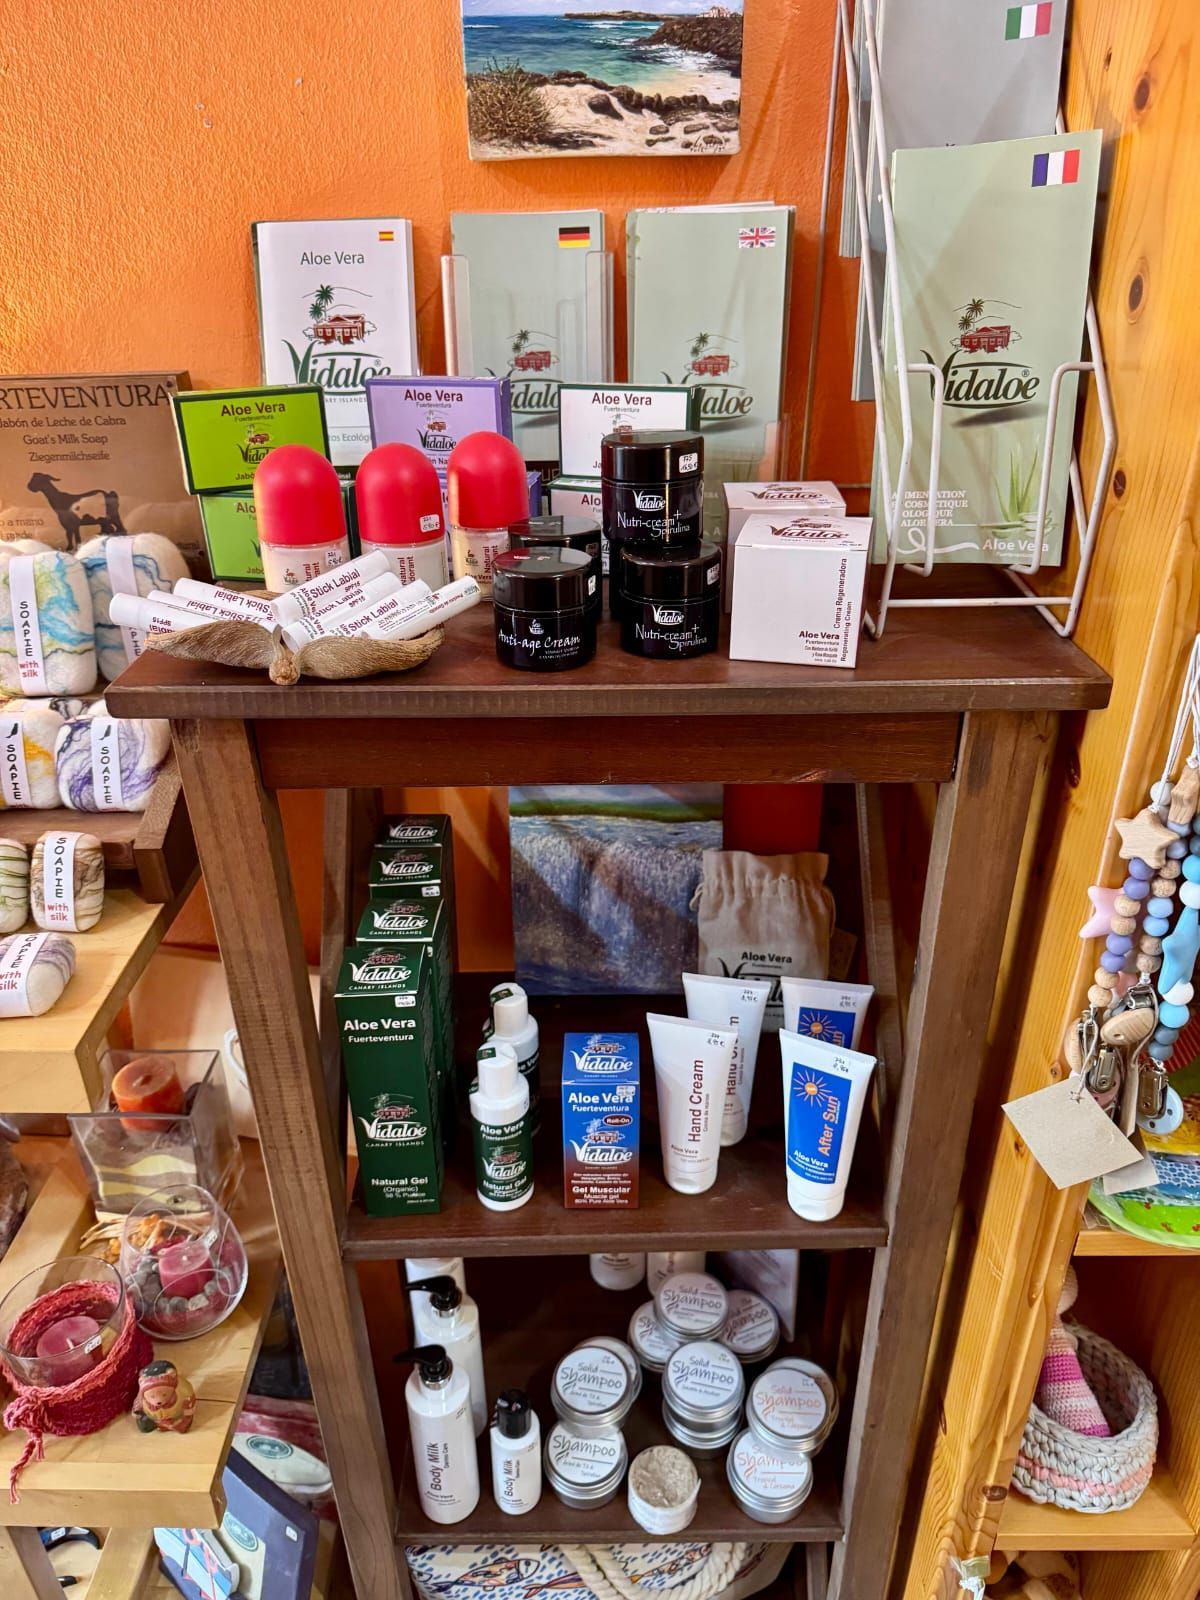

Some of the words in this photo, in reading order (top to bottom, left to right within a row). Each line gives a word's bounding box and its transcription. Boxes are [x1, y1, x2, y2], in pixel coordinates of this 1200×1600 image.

[300, 251, 331, 265] Aloe
[334, 251, 365, 265] Vera
[919, 349, 1041, 403] Vidaloe
[404, 389, 432, 401] Aloe
[435, 390, 464, 402] Vera
[592, 392, 620, 405] Aloe
[624, 393, 652, 406] Vera
[221, 403, 252, 417] Aloe
[255, 402, 286, 414] Vera
[604, 405, 640, 413] Fuerteventura
[32, 416, 43, 426] de
[47, 416, 77, 427] Leche
[79, 415, 92, 426] de
[94, 415, 127, 426] Cabra
[23, 434, 56, 445] Goat's
[58, 433, 80, 444] Milk
[82, 433, 108, 446] Soap
[416, 428, 457, 451] Vidaloe
[236, 443, 268, 465] Vidal
[236, 502, 255, 514] Alo
[581, 494, 602, 507] Alo
[632, 489, 666, 512] Vidaloe
[650, 523, 691, 540] Spirulina
[982, 538, 1016, 551] Aloe
[1018, 539, 1049, 552] Vea
[482, 546, 492, 574] Natural
[309, 582, 335, 599] Stick
[332, 568, 361, 587] Labial
[836, 557, 848, 606] Regeneradora
[186, 599, 218, 615] Labial
[214, 590, 246, 606] Labial
[245, 598, 271, 614] Stick
[347, 614, 374, 632] Stick
[370, 598, 399, 619] Labial
[652, 604, 684, 626] Vidaloe
[834, 607, 843, 629] Crema
[19, 600, 34, 657] SOAPIE
[799, 630, 820, 639] Aloe
[820, 631, 840, 640] Vera
[498, 629, 541, 656] Anti-age
[544, 635, 581, 649] Cream
[19, 660, 40, 670] with
[22, 669, 39, 679] silk
[6, 743, 22, 800] SOAPIE
[99, 746, 113, 804] SOAPIE
[388, 824, 438, 839] Vidaloe
[54, 837, 67, 898] SOAPIE
[379, 860, 434, 876] Vidaloe
[47, 902, 69, 912] with
[50, 912, 68, 921] silk
[371, 910, 429, 930] Vidaloe
[741, 951, 767, 961] Aloe
[767, 952, 793, 964] Vera
[349, 962, 412, 985] Vidaloe
[343, 1019, 379, 1031] Aloe
[380, 1018, 417, 1029] Vera
[348, 1033, 415, 1043] Fuerteventura
[570, 1050, 634, 1074] Vidaloe
[689, 1060, 704, 1105] Cream
[567, 1092, 600, 1104] Aloe
[601, 1092, 634, 1104] Vera
[572, 1104, 630, 1112] Fuerteventura
[823, 1095, 838, 1123] Sun
[357, 1116, 428, 1142] Vidaloe
[480, 1124, 502, 1135] Aloe
[503, 1120, 525, 1134] Vera
[688, 1108, 702, 1142] Hand
[818, 1123, 834, 1157] After
[569, 1139, 633, 1165] Vidaloe
[793, 1149, 811, 1162] Aloe
[811, 1156, 829, 1168] Vera
[482, 1156, 527, 1180] Vidaloe
[371, 1177, 409, 1186] Natural
[410, 1176, 429, 1185] Gel
[483, 1179, 513, 1191] Natural
[514, 1175, 528, 1187] Gel
[572, 1186, 588, 1194] Gel
[589, 1186, 632, 1194] Muscular
[663, 1288, 722, 1309] Shampoo
[578, 1361, 599, 1373] Solid
[689, 1356, 711, 1368] Solid
[560, 1366, 623, 1389] Shampoo
[671, 1360, 735, 1385] Shampoo
[754, 1391, 823, 1411] Shampoo
[426, 1442, 440, 1464] Milk
[552, 1434, 617, 1457] Shampoo
[503, 1459, 513, 1475] Milk
[429, 1465, 444, 1492] Body
[504, 1477, 516, 1497] Body
